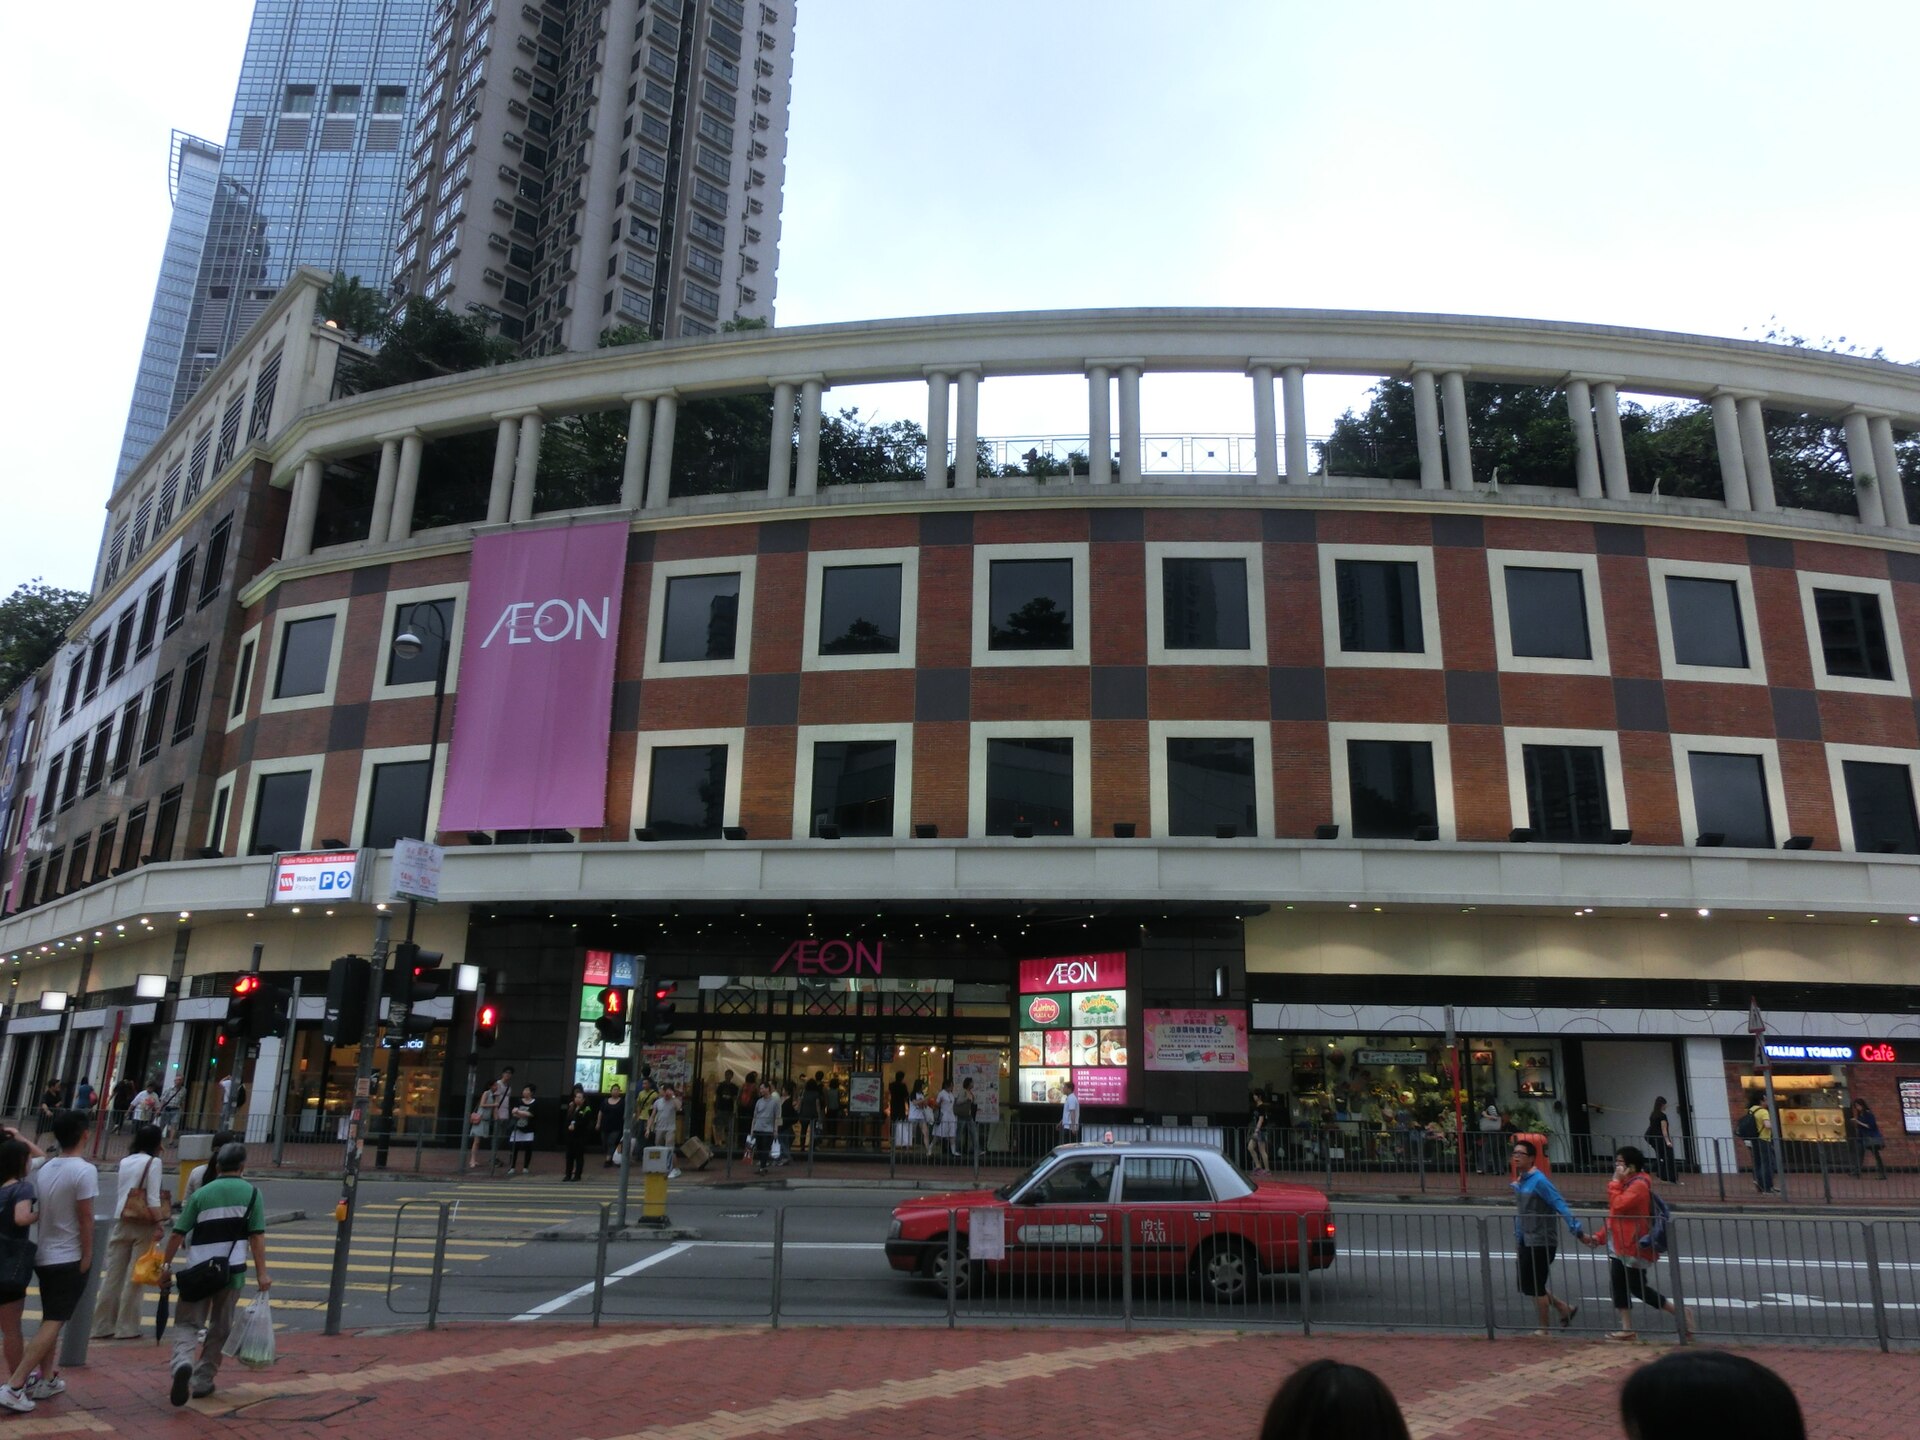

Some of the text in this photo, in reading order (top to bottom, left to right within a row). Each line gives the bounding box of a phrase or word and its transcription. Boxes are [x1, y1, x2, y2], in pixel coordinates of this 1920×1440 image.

[1806, 1046, 1852, 1058] TOMATO
[1860, 1044, 1896, 1062] Café
[1140, 1231, 1166, 1243] TAXI
